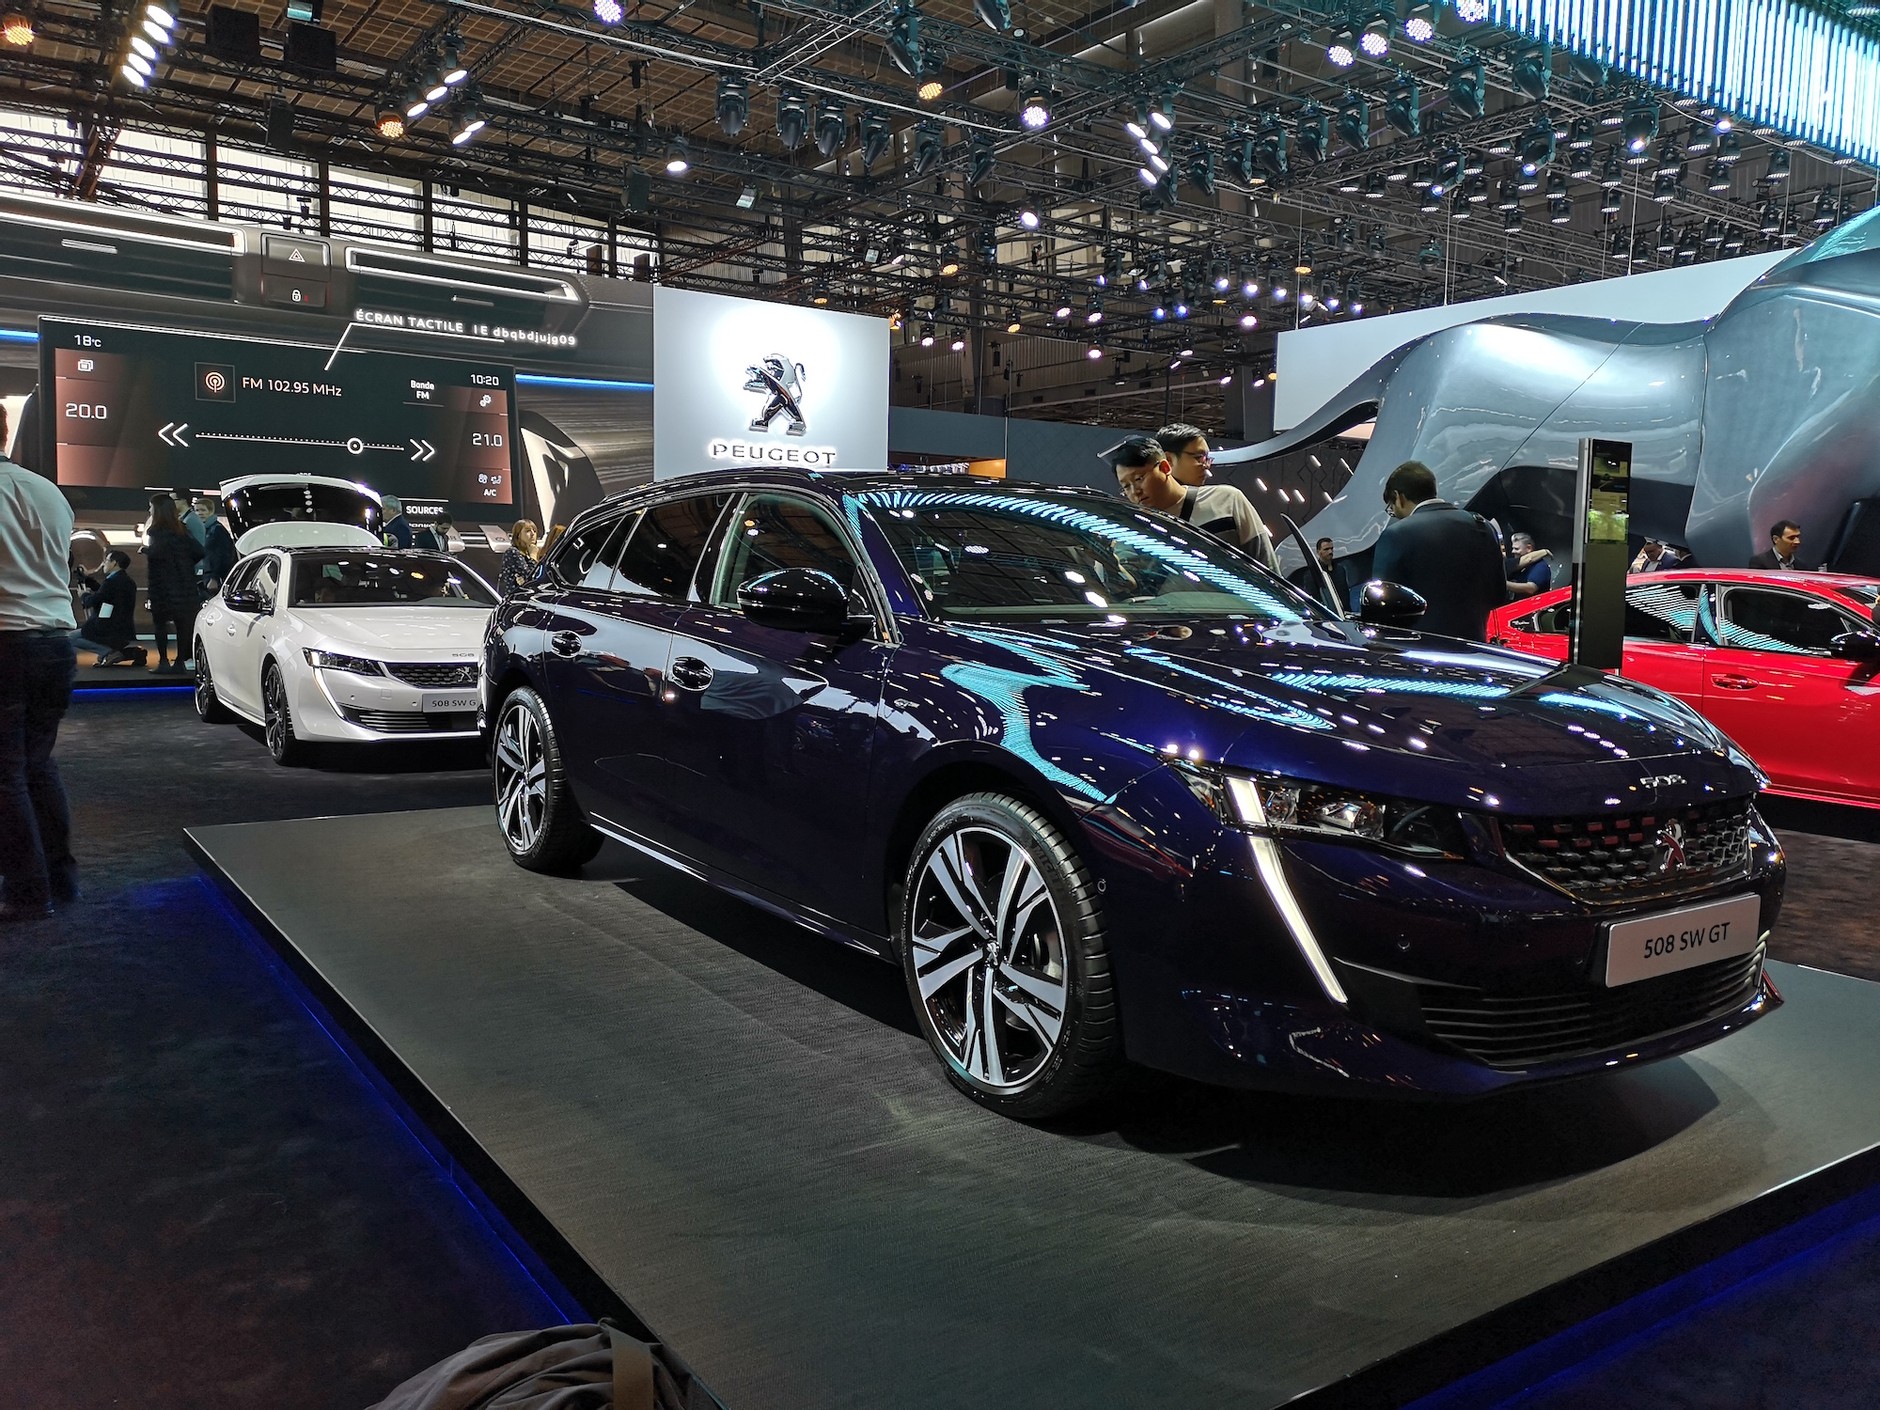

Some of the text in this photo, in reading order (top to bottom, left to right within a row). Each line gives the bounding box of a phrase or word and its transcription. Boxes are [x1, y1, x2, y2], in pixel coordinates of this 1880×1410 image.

[355, 308, 403, 326] ÉCRAN
[407, 316, 464, 333] TACTILE
[242, 377, 342, 397] FM 102.95 MHz
[410, 380, 435, 390] Bande
[470, 374, 500, 386] 10:20
[416, 391, 430, 400] FM
[65, 403, 107, 420] 20.0
[473, 433, 503, 447] 21.0
[713, 443, 836, 465] PEUGEOT
[483, 488, 497, 497] A/C
[431, 700, 450, 708] 508
[1644, 921, 1731, 958] 508 SW GT
